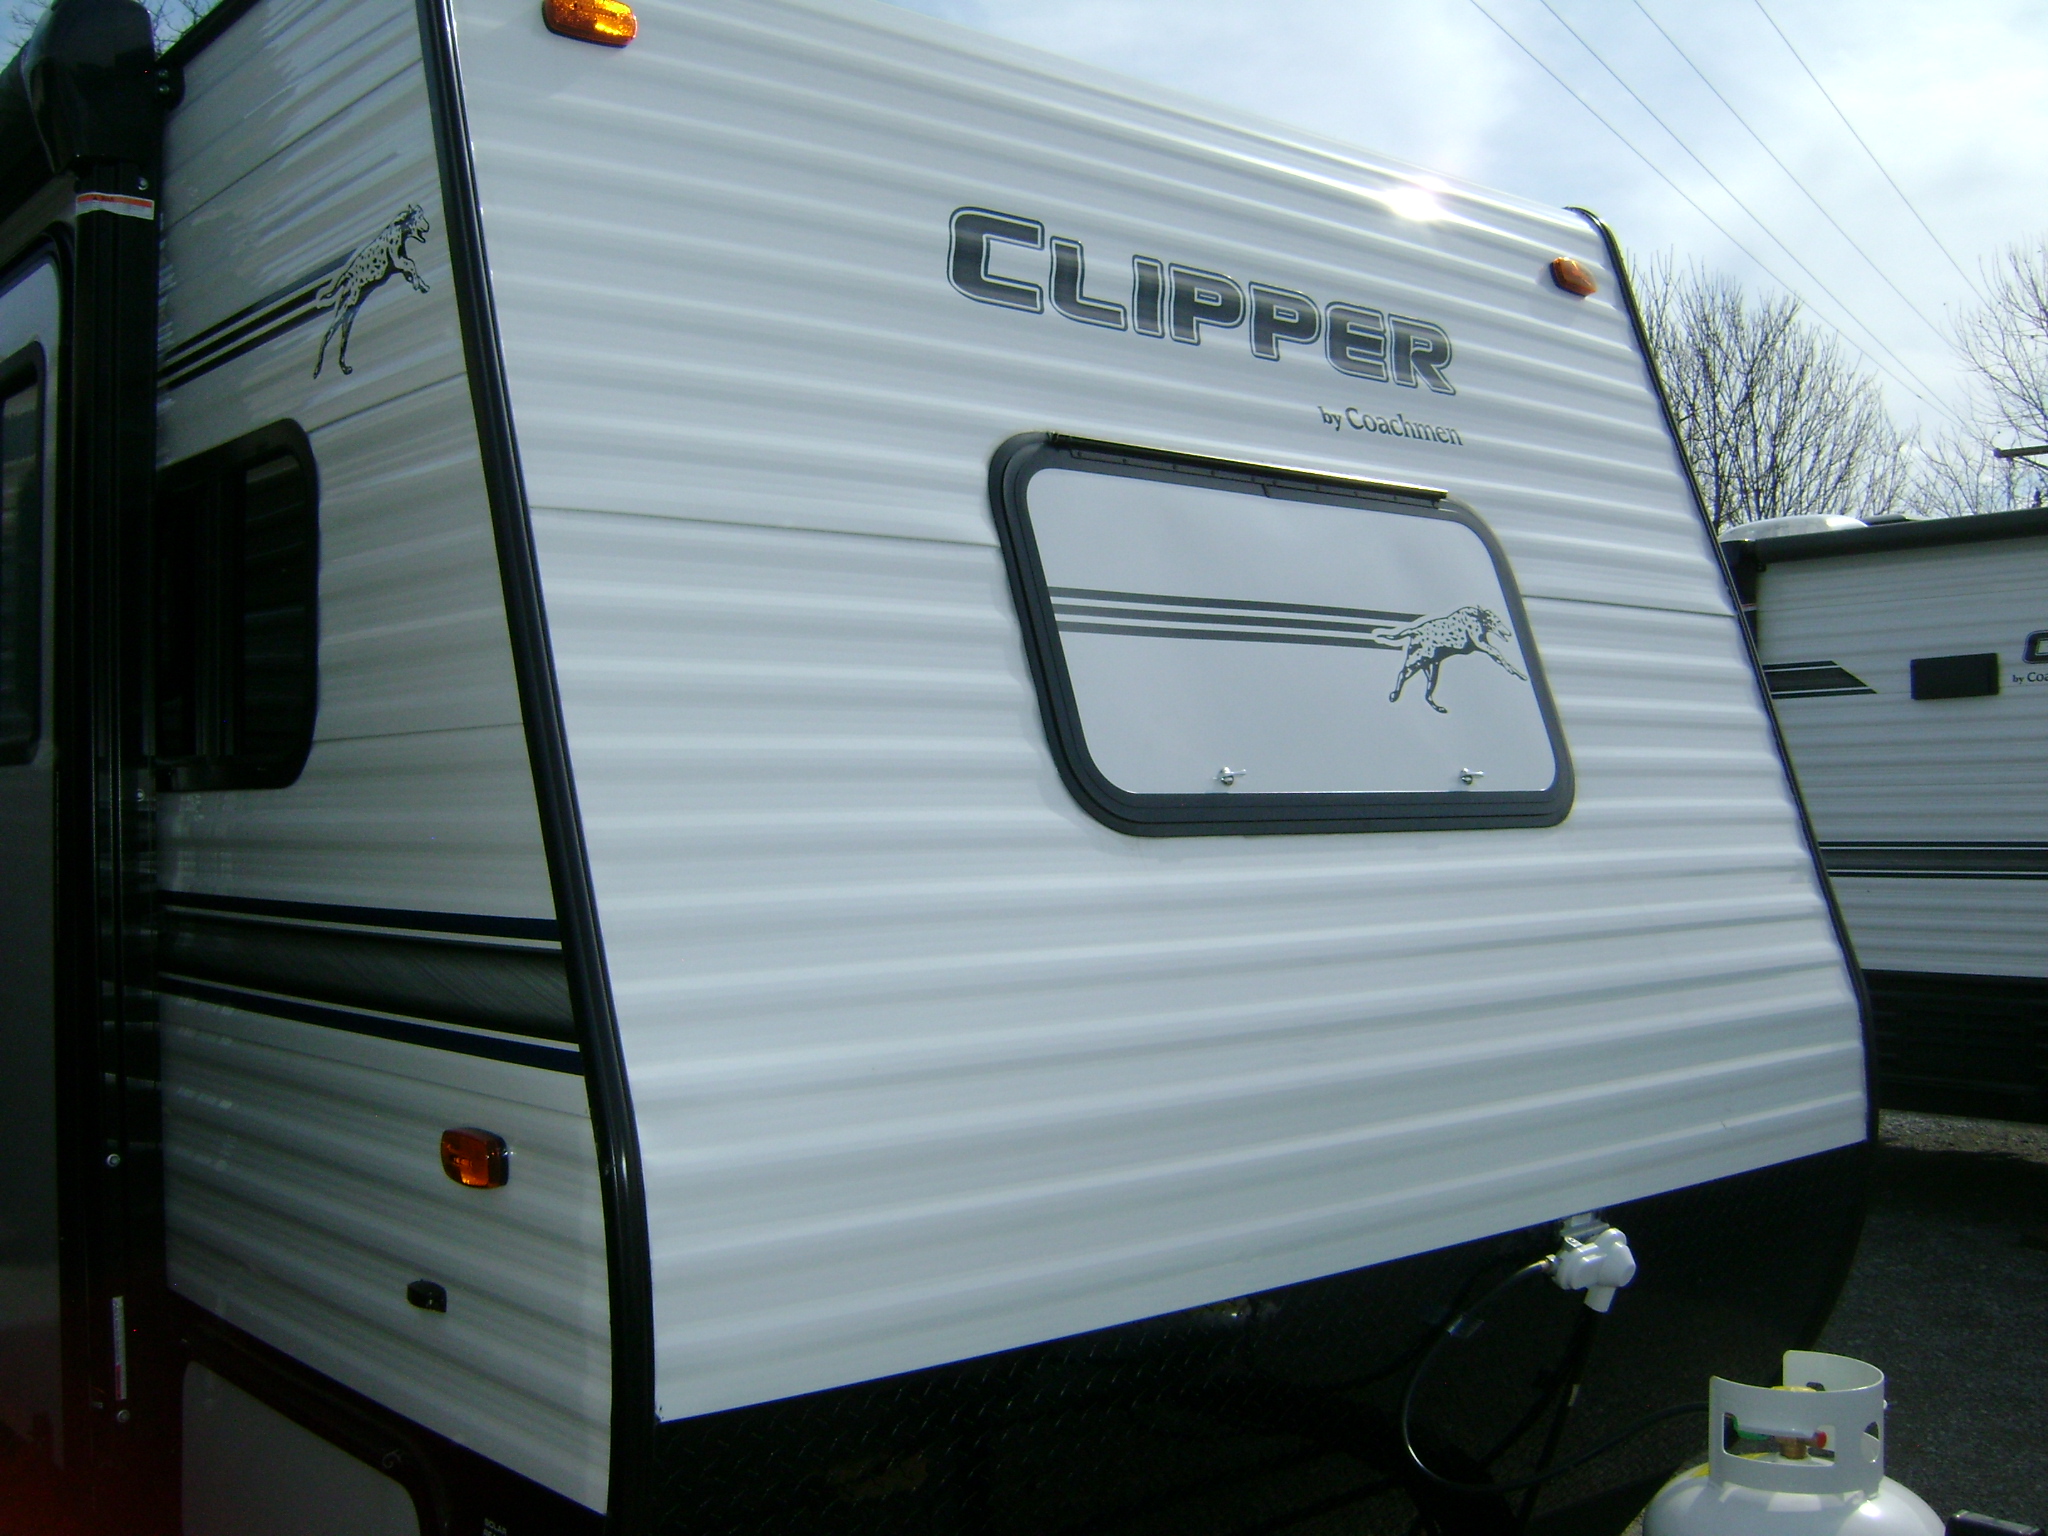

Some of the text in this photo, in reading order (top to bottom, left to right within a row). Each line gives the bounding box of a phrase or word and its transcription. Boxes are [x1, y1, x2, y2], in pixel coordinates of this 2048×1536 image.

[947, 206, 1456, 396] CLIPPER
[1317, 405, 1463, 446] by Coachmen
[2012, 674, 2024, 685] by
